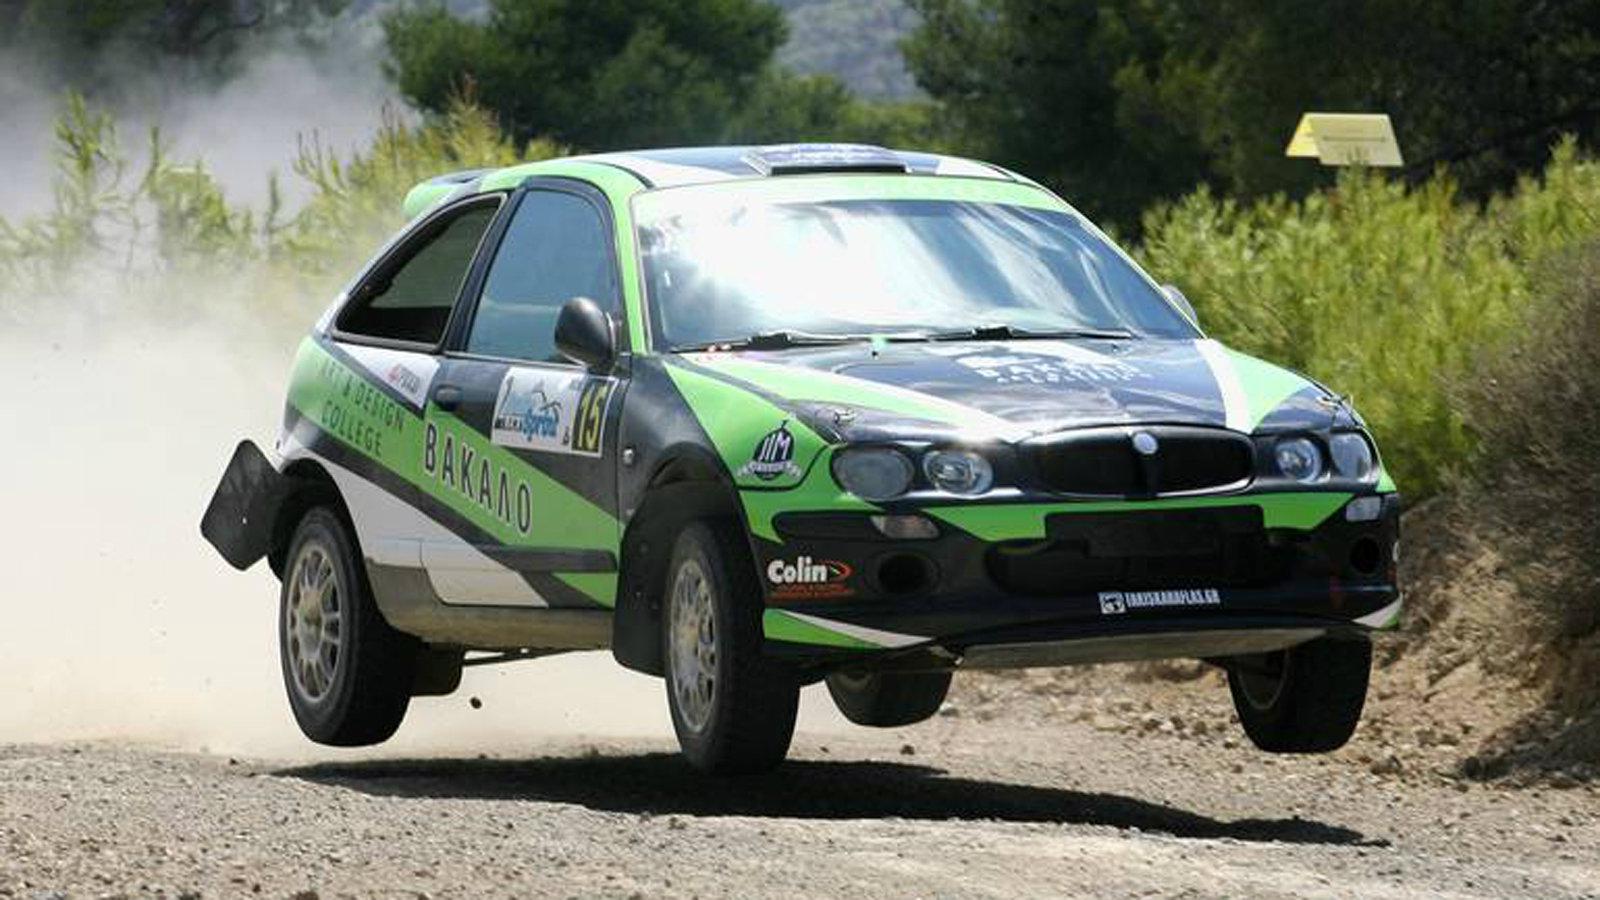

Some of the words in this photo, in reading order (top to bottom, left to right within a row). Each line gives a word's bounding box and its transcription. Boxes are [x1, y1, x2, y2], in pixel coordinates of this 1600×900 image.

[321, 399, 383, 457] COLLEGE
[354, 381, 405, 433] DESIGN
[578, 382, 608, 450] 15
[767, 556, 828, 583] Colin
